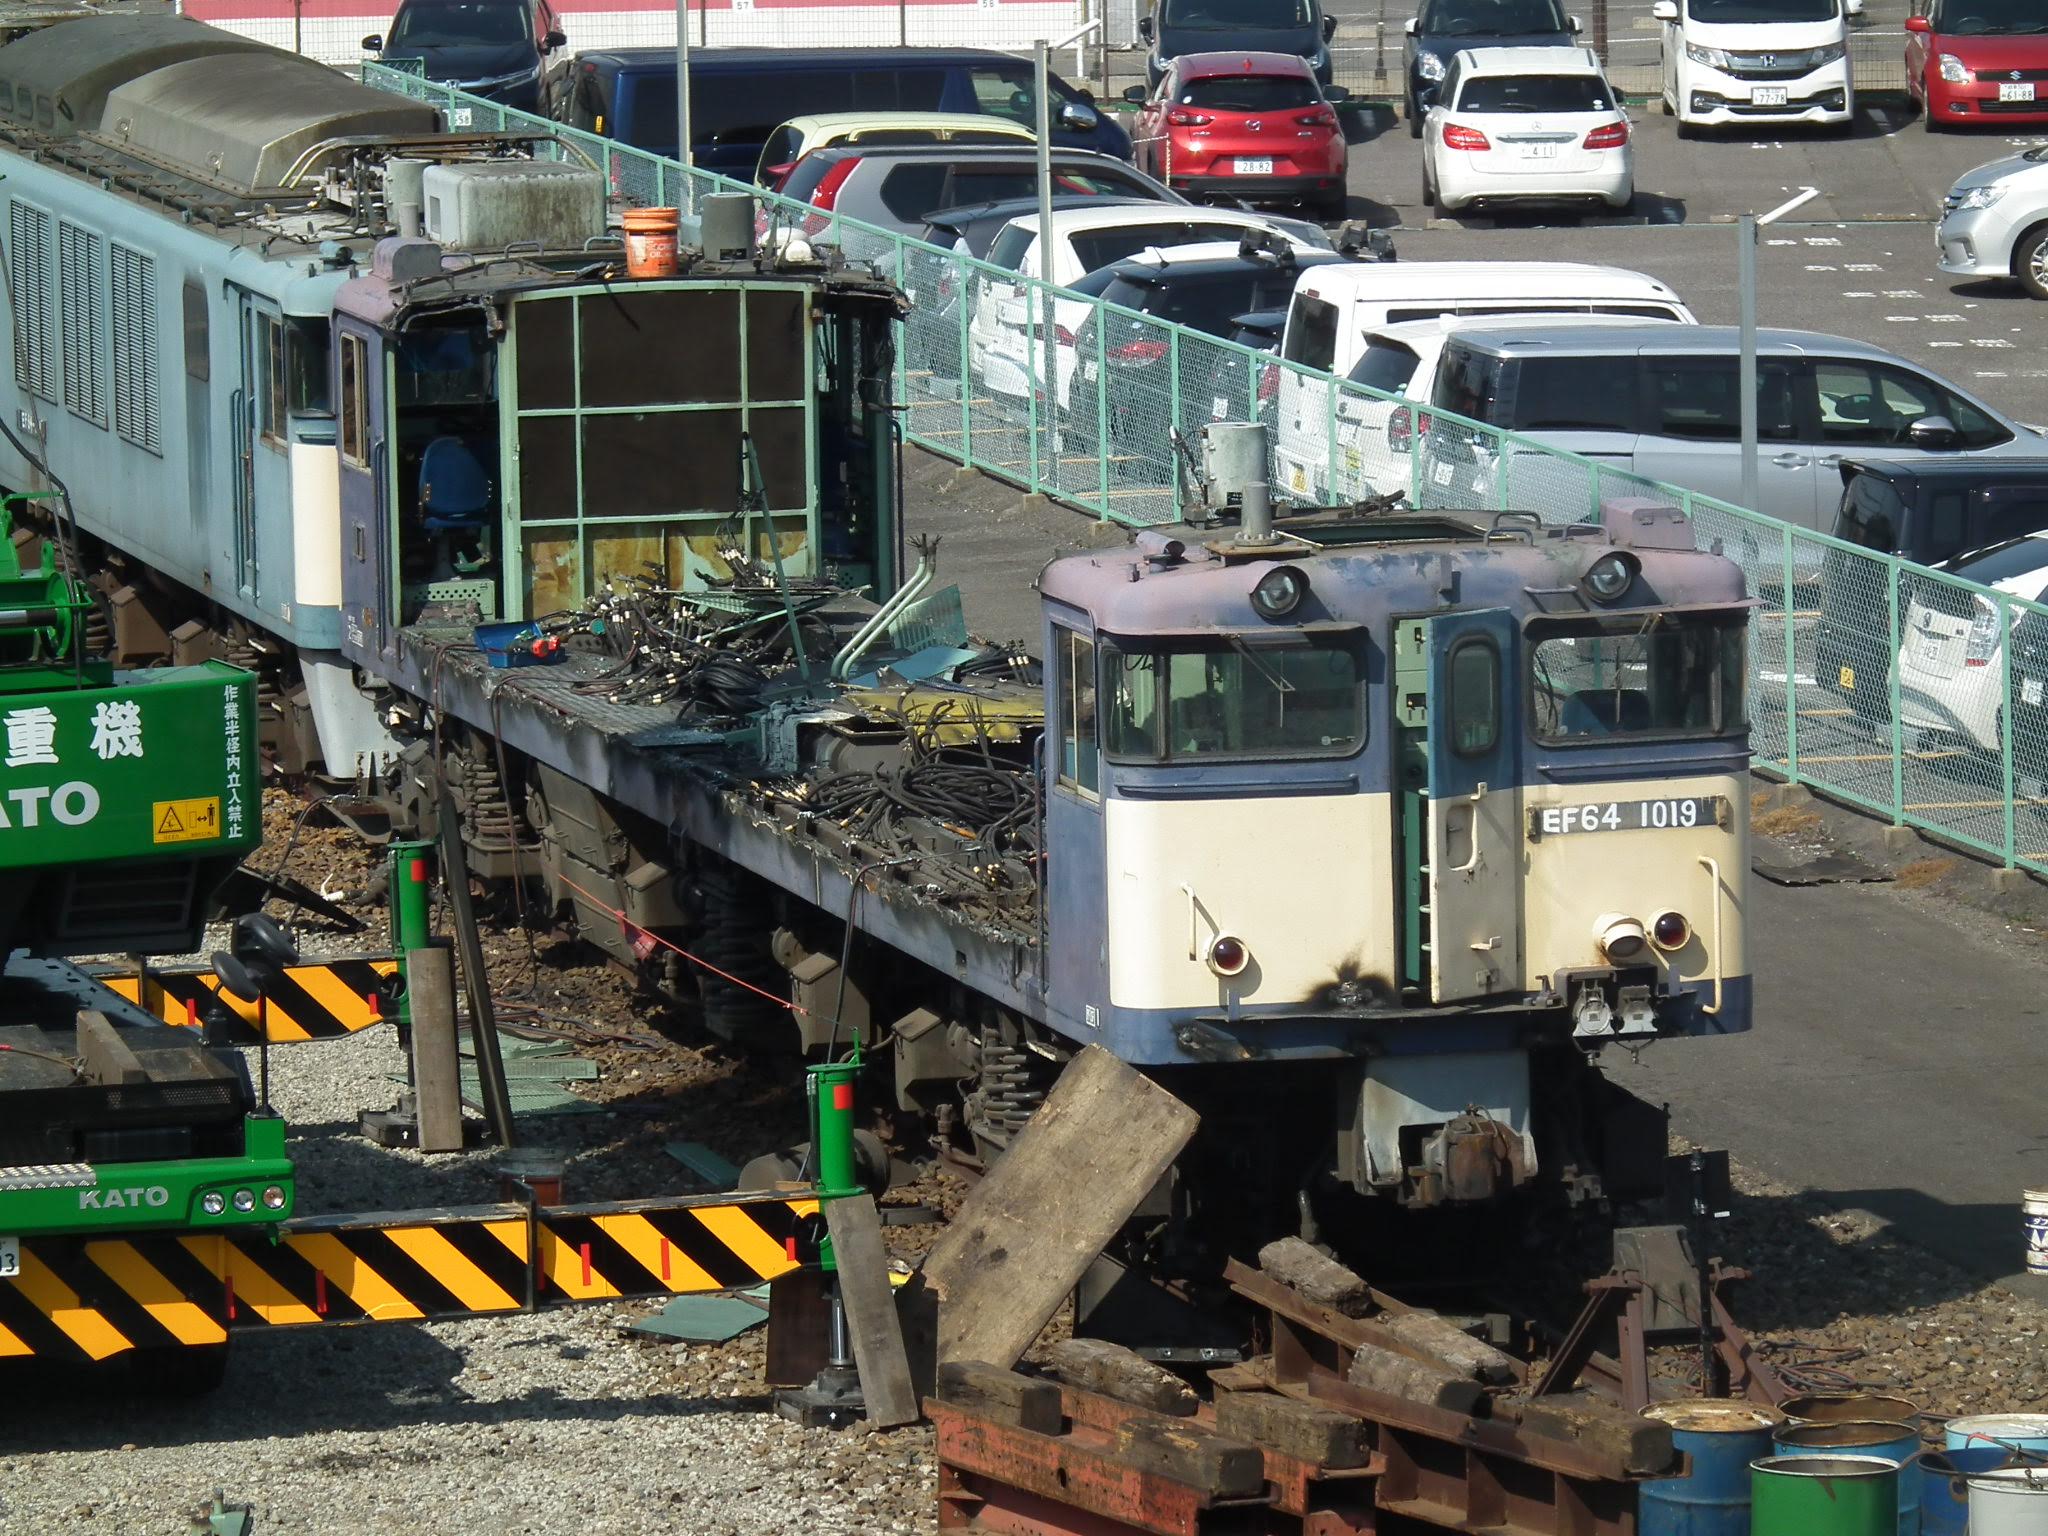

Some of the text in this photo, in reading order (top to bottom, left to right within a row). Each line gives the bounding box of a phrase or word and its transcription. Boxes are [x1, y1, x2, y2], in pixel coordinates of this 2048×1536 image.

[737, 1, 749, 10] 57
[2007, 90, 2033, 100] 61-88
[223, 684, 243, 839] 作業半径内立入禁止
[1543, 799, 1697, 834] EF64 1019
[79, 1185, 169, 1210] KATO
